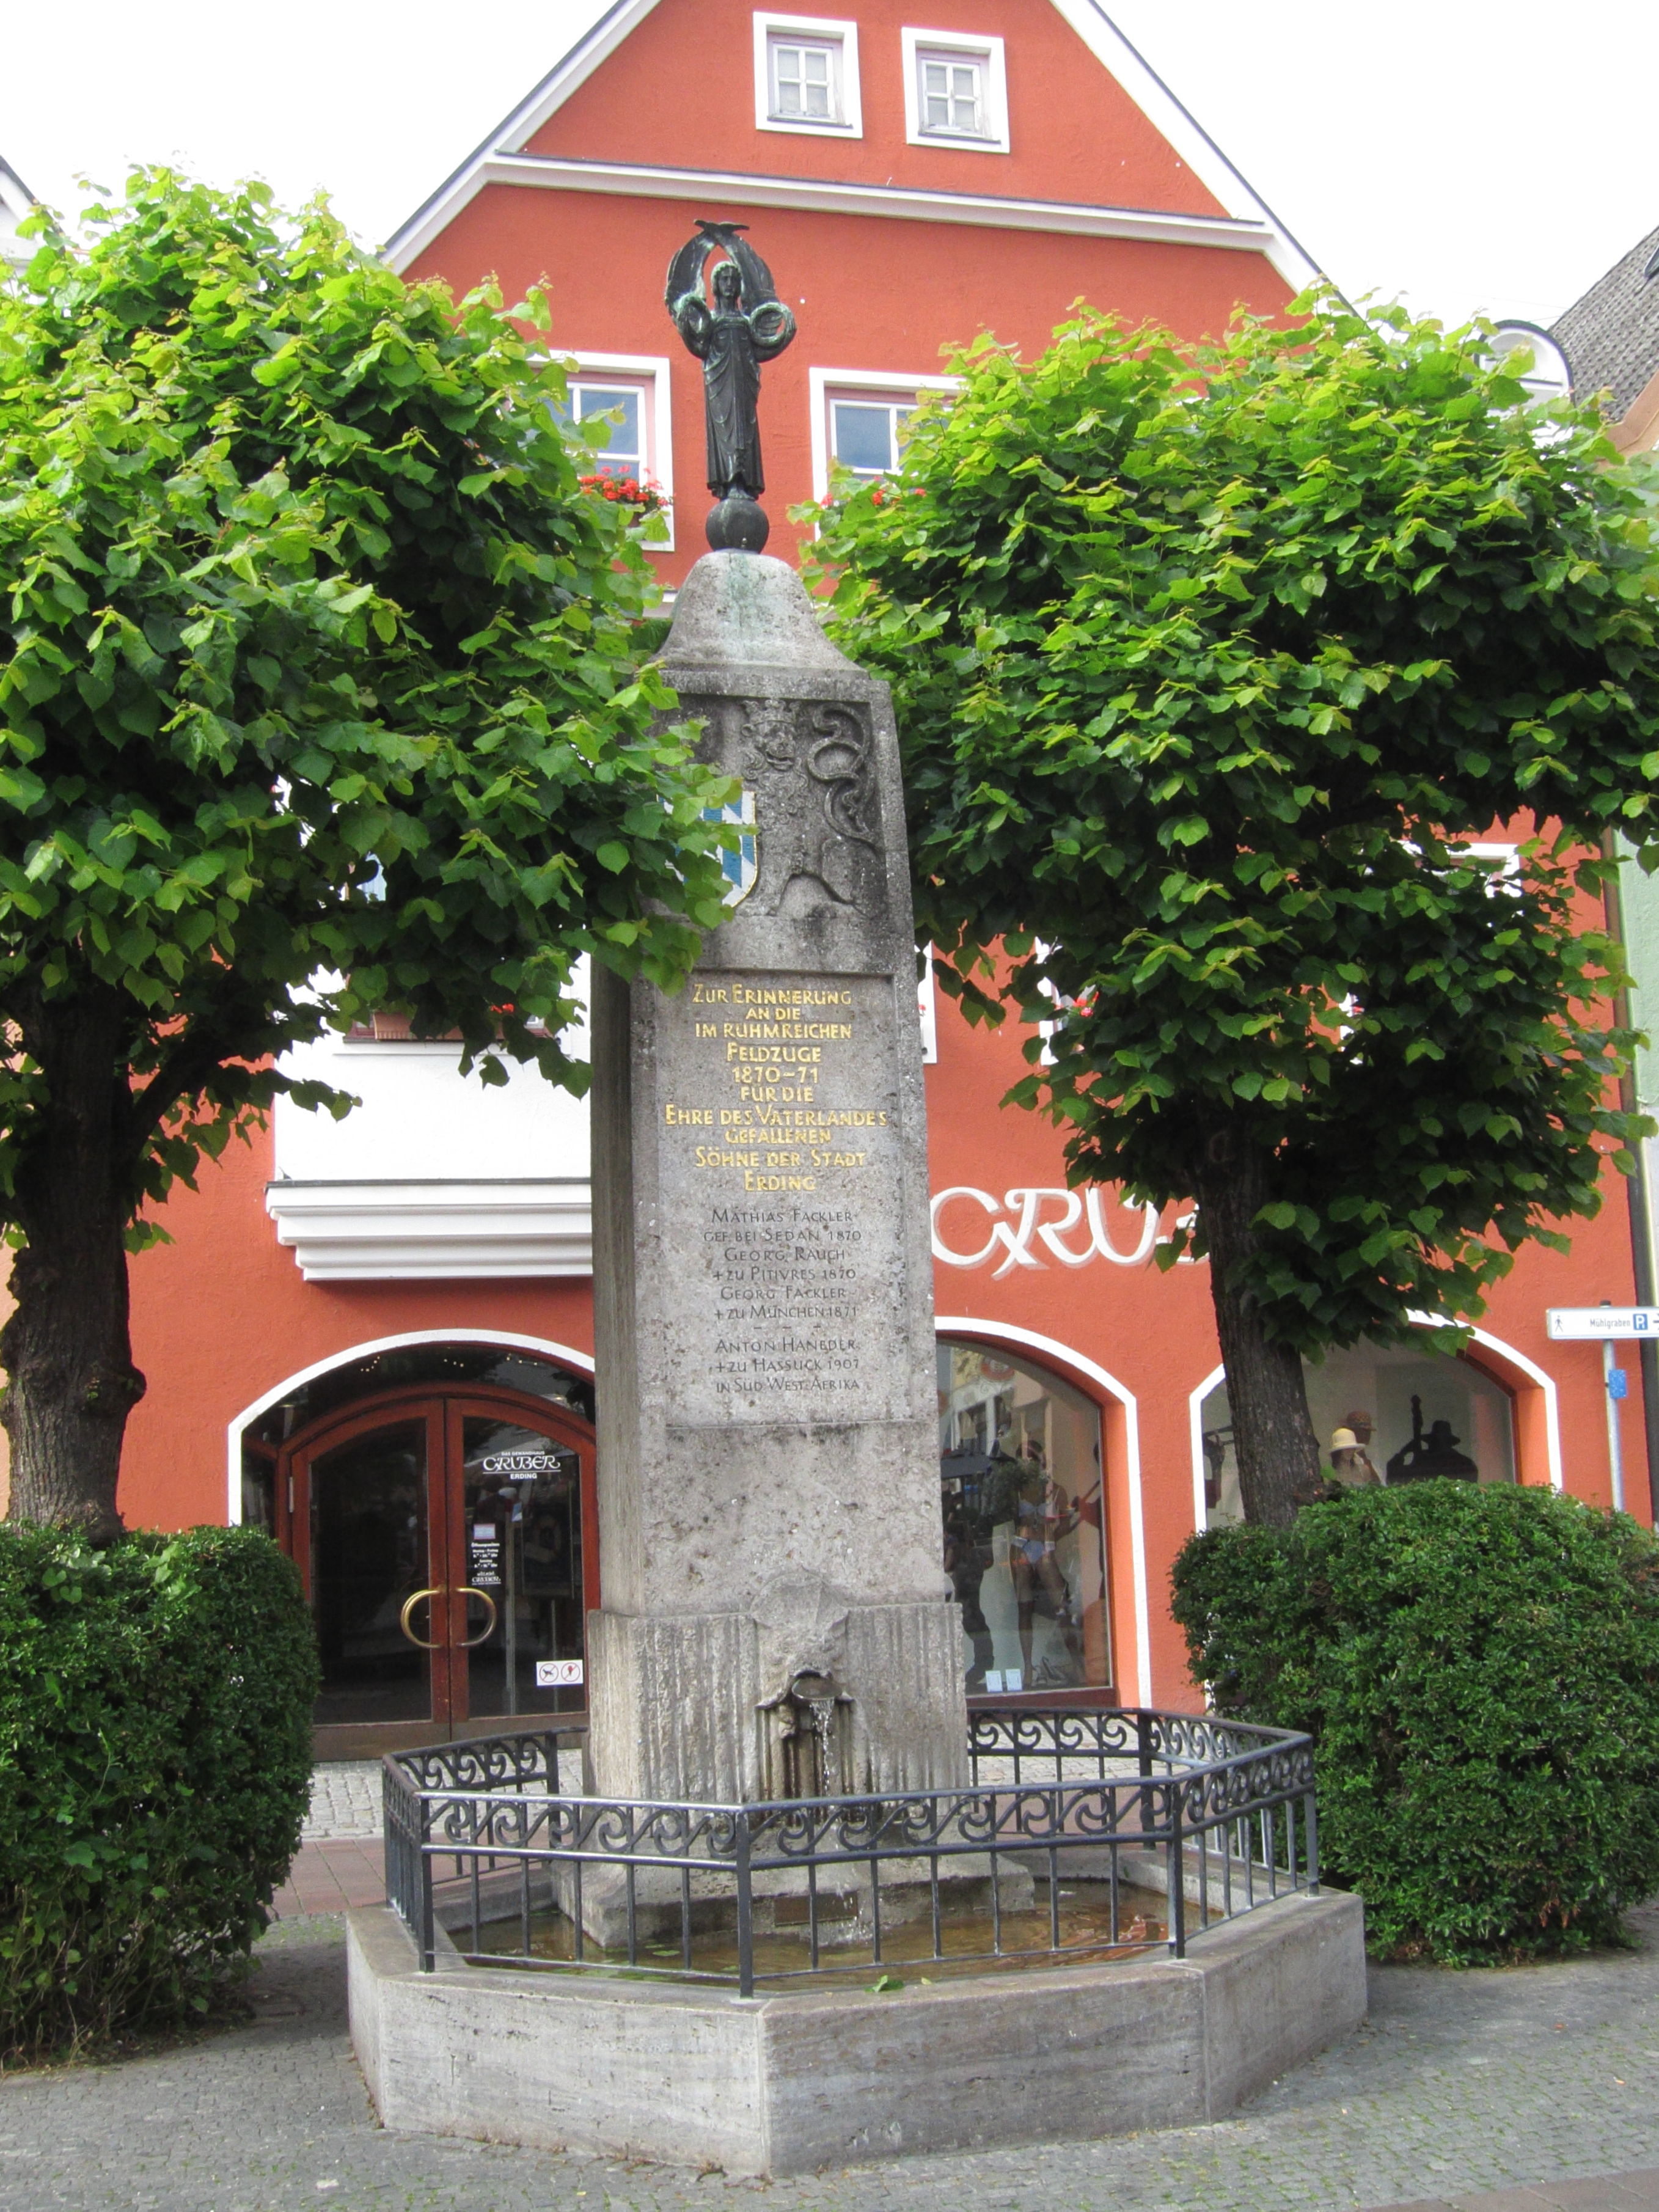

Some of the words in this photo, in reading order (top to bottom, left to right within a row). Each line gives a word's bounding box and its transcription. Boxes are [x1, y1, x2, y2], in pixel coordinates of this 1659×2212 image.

[692, 984, 728, 1004] ZUR
[733, 984, 852, 1005] ERINNERUNG
[745, 1008, 769, 1020] AN
[775, 1008, 800, 1020] DIE
[695, 1023, 717, 1038] IM
[723, 1023, 852, 1039] RUHMREICHEN
[727, 1042, 821, 1063] FELDZUGE
[782, 1087, 815, 1103] DIE
[665, 1104, 713, 1125] EHRE
[720, 1109, 753, 1126] DES
[755, 1105, 888, 1126] VATERLANDES
[725, 1128, 832, 1144] GEFALLENEN
[695, 1146, 760, 1168] SÖHNE
[766, 1152, 800, 1168] DER
[810, 1149, 866, 1168] STADT
[744, 1170, 816, 1192] ERDING
[711, 1208, 784, 1223] MATHIAS
[793, 1208, 853, 1223] FACKLER
[735, 1231, 756, 1242] BEI
[764, 1228, 820, 1242] SEDAN
[829, 1230, 862, 1242] 1870
[795, 1245, 846, 1262] RAUCH
[824, 1267, 857, 1280] 1870
[720, 1286, 775, 1301] GEORG
[786, 1284, 847, 1300] FACKLER
[750, 1305, 825, 1319] MÜNCHEN
[827, 1305, 858, 1318] 1871
[1589, 1318, 1630, 1329] Mühlgraben
[715, 1339, 775, 1354] ANTON
[782, 1336, 856, 1352] HANEDER
[716, 1382, 730, 1393] IN
[733, 1377, 763, 1393] SÜD
[810, 1376, 860, 1391] AFRIKA
[483, 1455, 561, 1472] GRUBER
